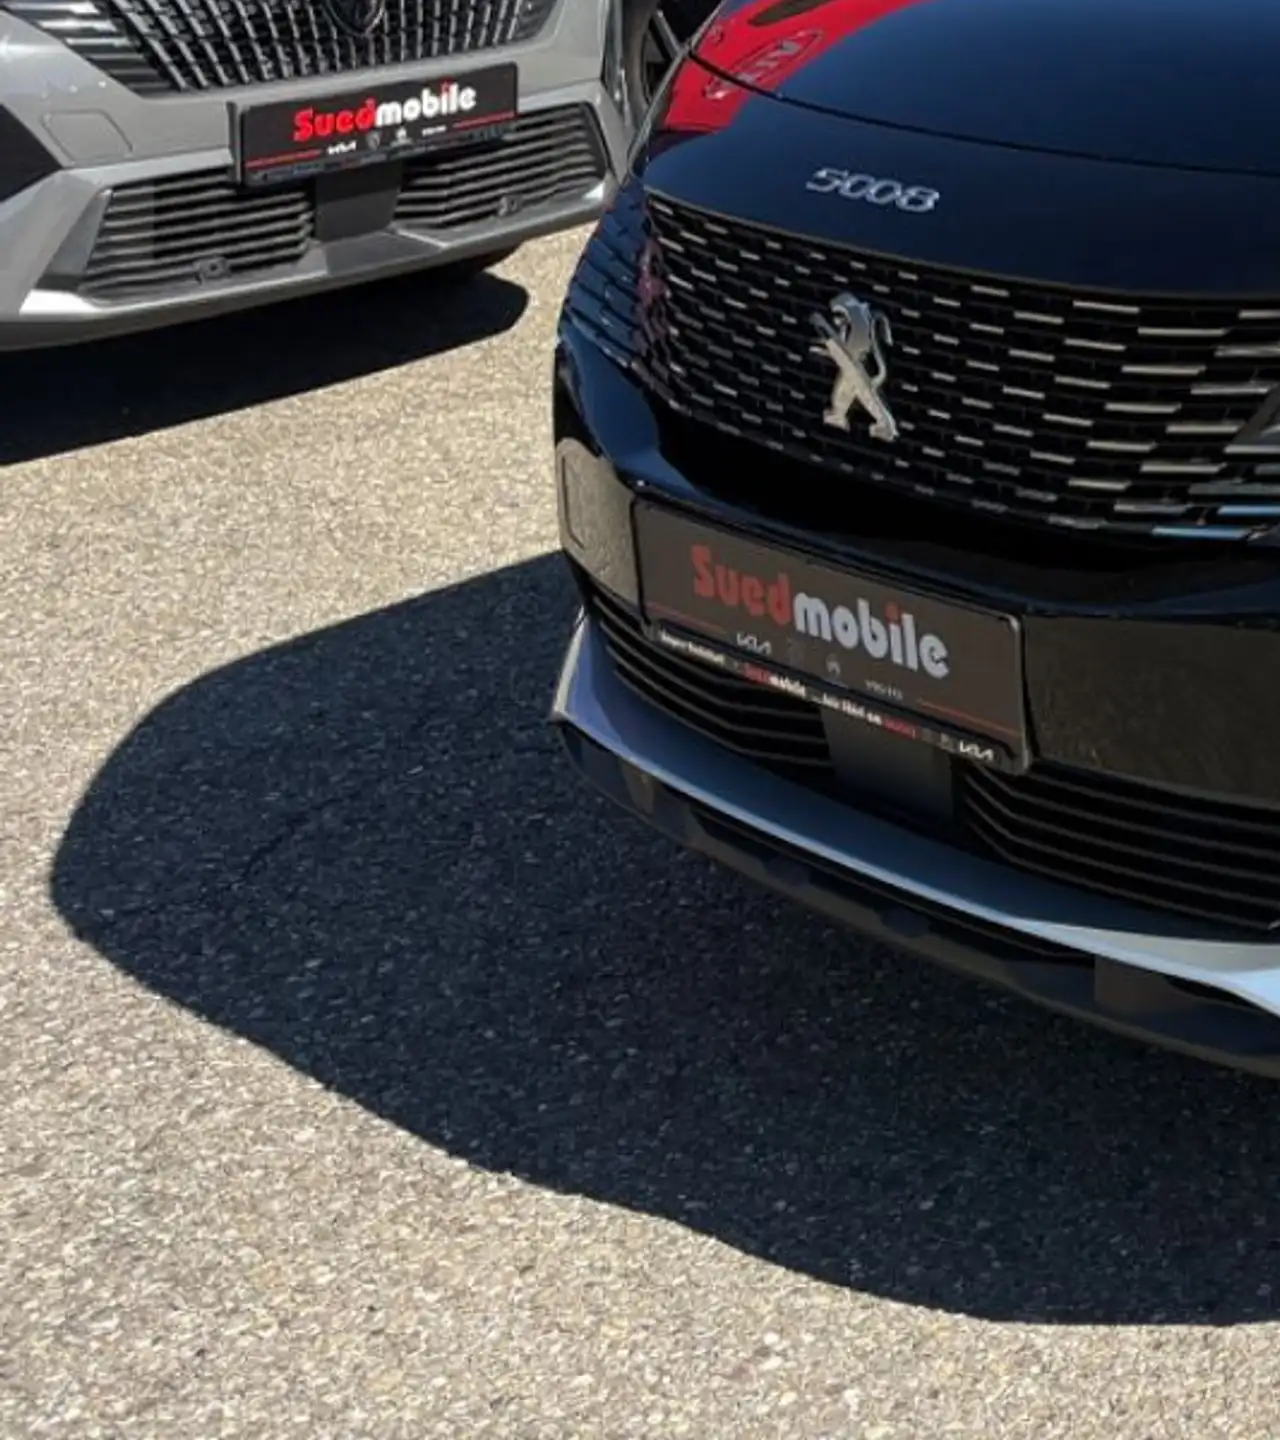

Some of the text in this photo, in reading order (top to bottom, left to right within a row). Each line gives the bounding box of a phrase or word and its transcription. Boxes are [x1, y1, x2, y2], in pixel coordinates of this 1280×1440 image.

[293, 80, 477, 142] Suedmobile
[805, 167, 941, 213] 5008
[691, 543, 950, 680] Suedmobile
